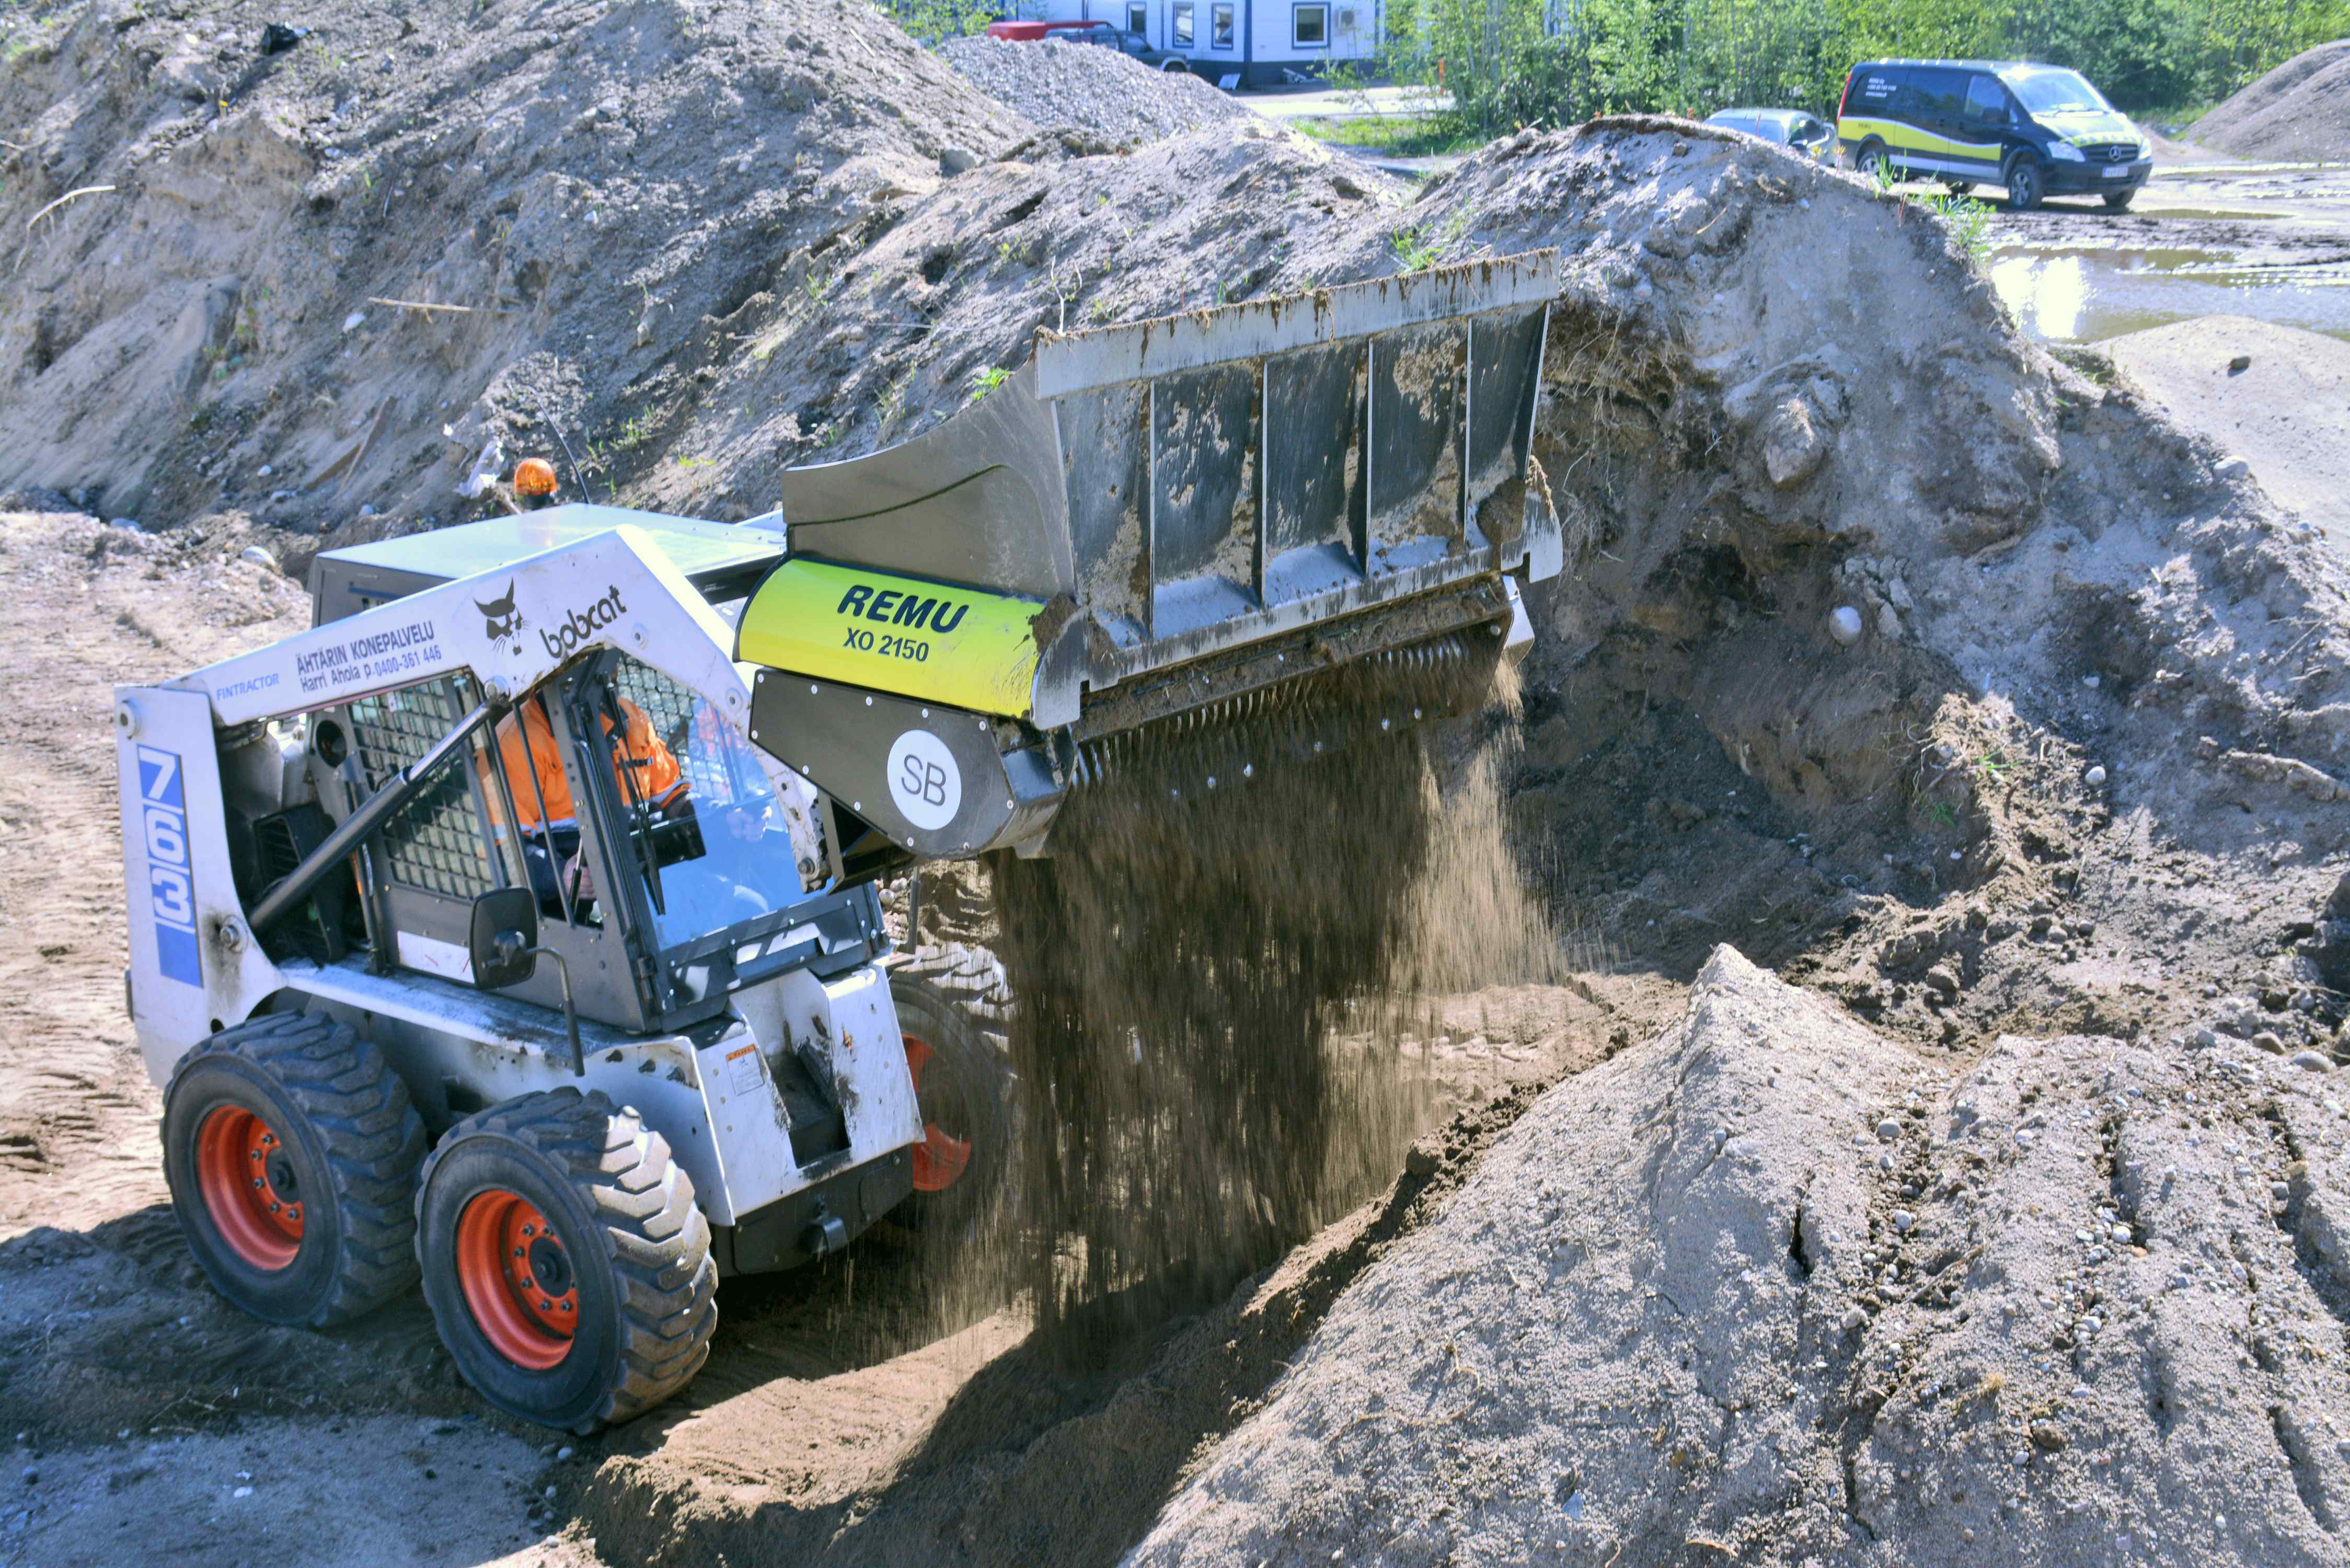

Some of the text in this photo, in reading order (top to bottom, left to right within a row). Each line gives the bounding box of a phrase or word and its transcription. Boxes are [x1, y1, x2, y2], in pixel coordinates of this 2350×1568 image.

[539, 584, 627, 659] bobcat
[837, 584, 970, 633] REMU
[296, 620, 435, 675] ÄHTÄRIN KONEPALVELU
[299, 672, 328, 693] Harri
[331, 664, 361, 685] Ahola
[423, 644, 442, 663] 446
[843, 627, 929, 662] XO 2150
[216, 673, 279, 701] FINTRACTOR
[900, 753, 947, 806] SB
[139, 746, 191, 924] 763
